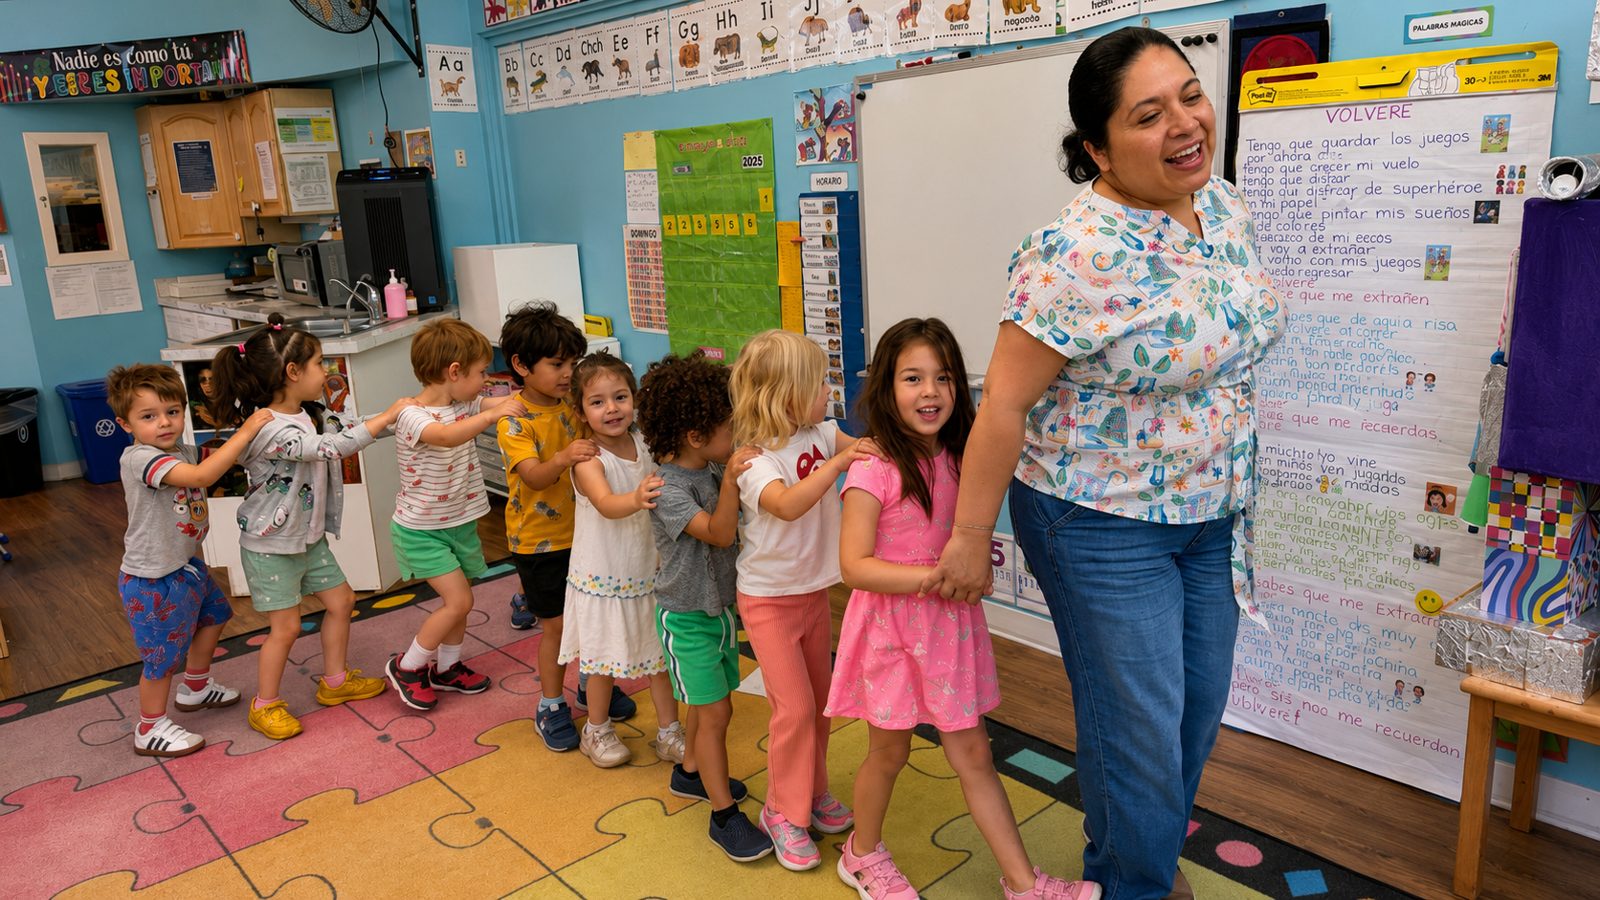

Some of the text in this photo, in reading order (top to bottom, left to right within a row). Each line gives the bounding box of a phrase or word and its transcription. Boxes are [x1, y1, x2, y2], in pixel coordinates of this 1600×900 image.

[761, 0, 773, 20] Ii
[716, 9, 738, 31] Hh
[1413, 17, 1484, 32] PALABRAS MAGICAS
[645, 25, 660, 46] Ff
[678, 20, 699, 41] Gg
[581, 38, 604, 56] Chch
[613, 34, 629, 52] Ee
[52, 42, 194, 72] Nadie es como tú
[530, 52, 544, 68] Cc
[556, 45, 572, 62] Dd
[505, 57, 519, 73] Bb
[1464, 77, 1476, 85] 30
[1537, 73, 1551, 82] 3M
[1326, 103, 1413, 124] VOLVERE
[1246, 138, 1281, 155] Tengo
[1289, 140, 1313, 153] que
[1391, 131, 1412, 145] los
[1419, 132, 1470, 148] juegos
[742, 155, 763, 167] 2025
[1247, 155, 1266, 166] por
[1274, 150, 1312, 162] ahora
[1243, 163, 1275, 177] tengo
[1280, 165, 1303, 178] que
[1357, 160, 1373, 171] mi
[1383, 157, 1420, 170] vuelo
[816, 177, 842, 185] HORARIO
[1243, 175, 1275, 188] tengo
[1280, 175, 1303, 189] que
[763, 194, 769, 203] 1
[1242, 186, 1274, 200] tengo
[1364, 181, 1383, 195] de
[1393, 180, 1483, 199] superhéroe
[1288, 210, 1312, 223] que
[1322, 206, 1368, 223] pintar
[1376, 208, 1405, 219] mis
[1415, 206, 1470, 219] sueños
[667, 221, 673, 230] 2
[682, 220, 687, 229] 2
[1309, 231, 1324, 243] de
[1333, 232, 1350, 243] mi
[1270, 243, 1376, 256] voy a extrañar
[1264, 265, 1353, 281] uedo regresar
[1310, 257, 1334, 266] con
[1342, 256, 1368, 267] mis
[1373, 256, 1421, 273] juegos
[1299, 290, 1325, 304] que
[1333, 292, 1353, 302] me
[1317, 313, 1341, 328] que
[1350, 313, 1367, 326] de
[1424, 318, 1458, 332] risa
[1292, 413, 1319, 427] que
[1329, 417, 1351, 429] me
[1321, 464, 1344, 476] ven
[1347, 455, 1377, 469] vine
[991, 540, 1006, 567] 5
[1256, 576, 1295, 596] sabes
[1303, 588, 1329, 605] que
[1340, 597, 1364, 611] me
[1382, 628, 1417, 649] muy
[1232, 681, 1260, 695] pero
[1338, 711, 1363, 728] me
[1375, 722, 1460, 759] recuerdan
